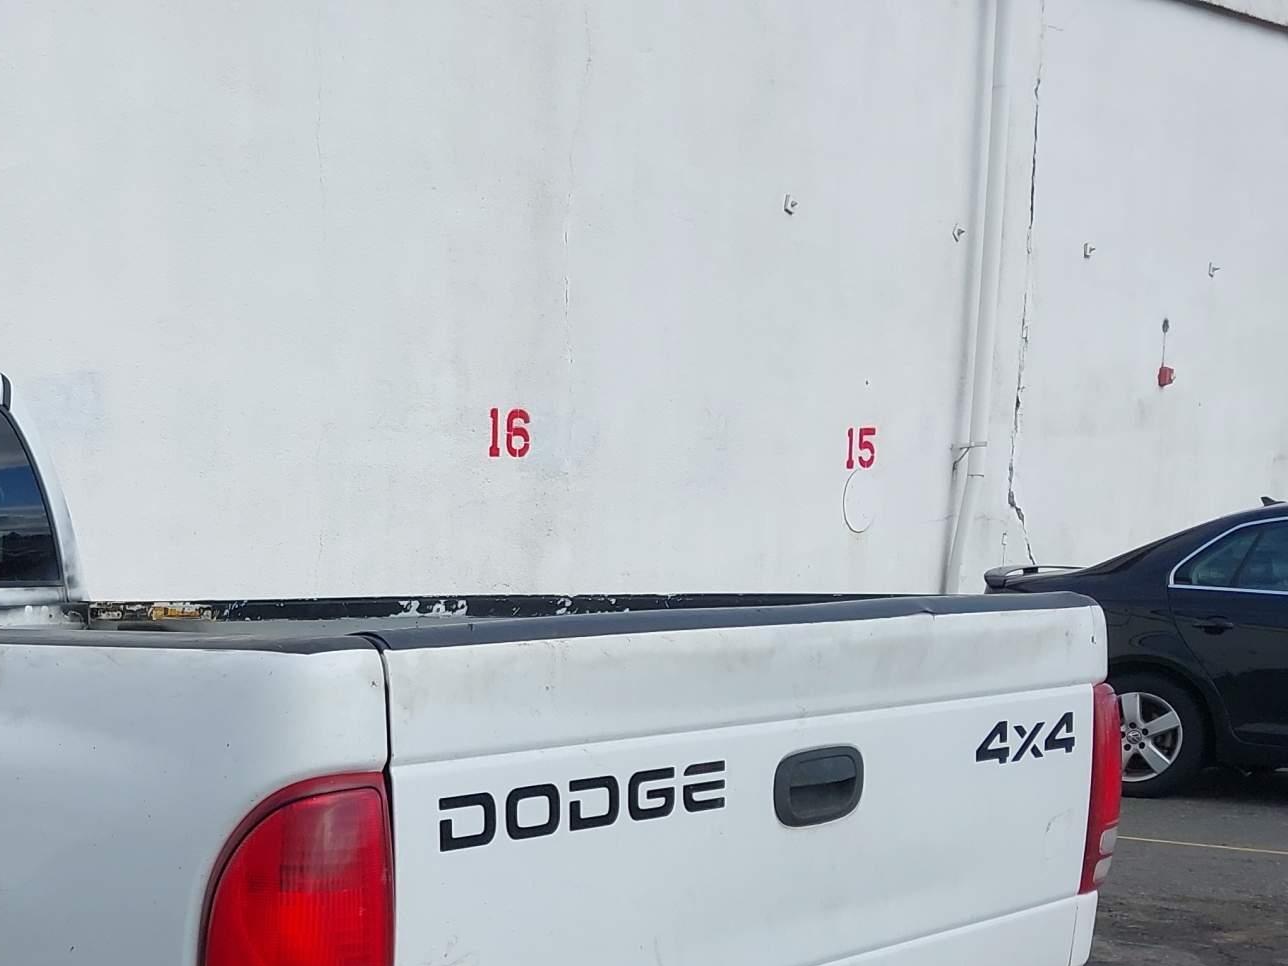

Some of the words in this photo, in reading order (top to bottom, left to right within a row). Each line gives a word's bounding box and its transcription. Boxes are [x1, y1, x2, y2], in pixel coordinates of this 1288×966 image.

[489, 408, 530, 458] 16
[846, 427, 876, 469] 15
[438, 760, 725, 852] DODGE
